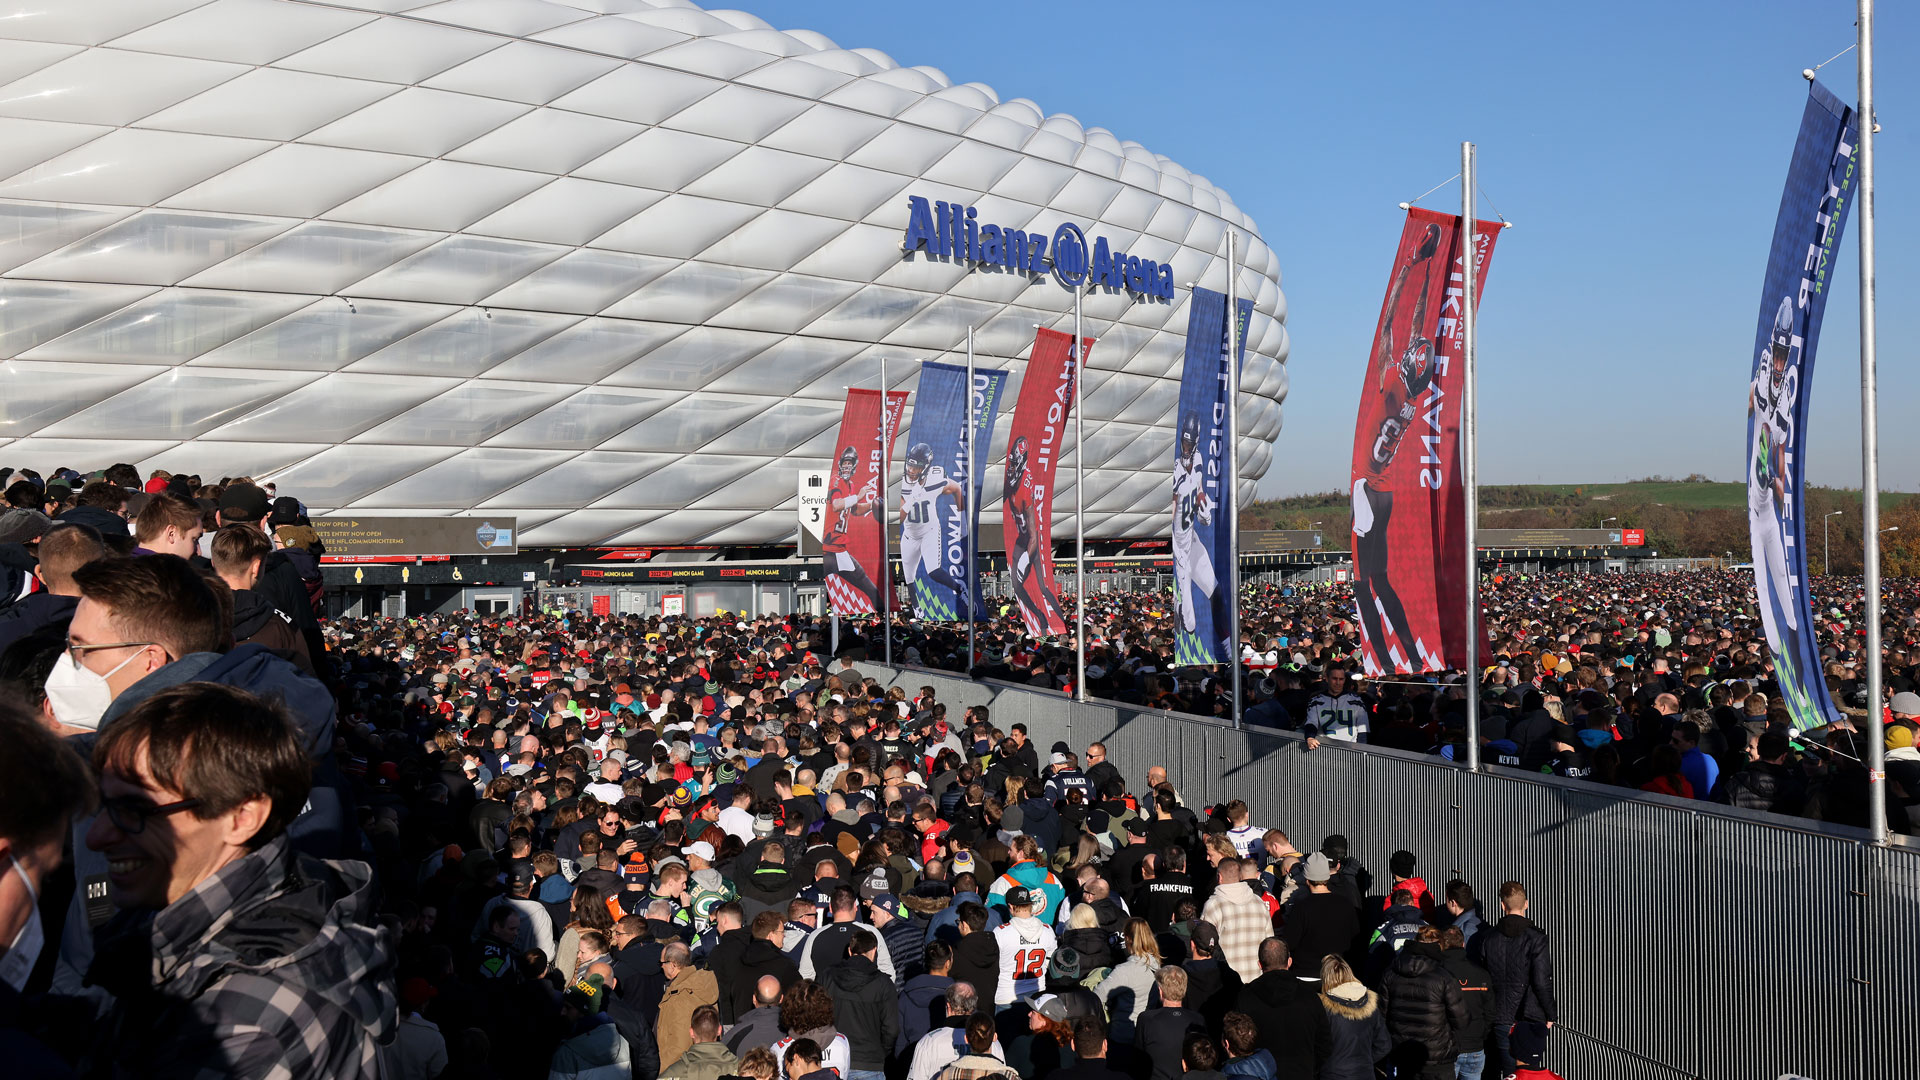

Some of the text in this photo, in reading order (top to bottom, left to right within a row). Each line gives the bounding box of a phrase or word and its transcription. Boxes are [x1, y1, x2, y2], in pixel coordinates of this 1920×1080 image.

[905, 195, 1175, 299] Allianz Arena
[811, 508, 820, 522] 3
[1320, 710, 1353, 736] 24
[1498, 755, 1520, 766] NEWTON
[1236, 840, 1256, 850] ALLEN
[1150, 884, 1194, 894] FRANKFURT
[1012, 948, 1046, 980] 12
